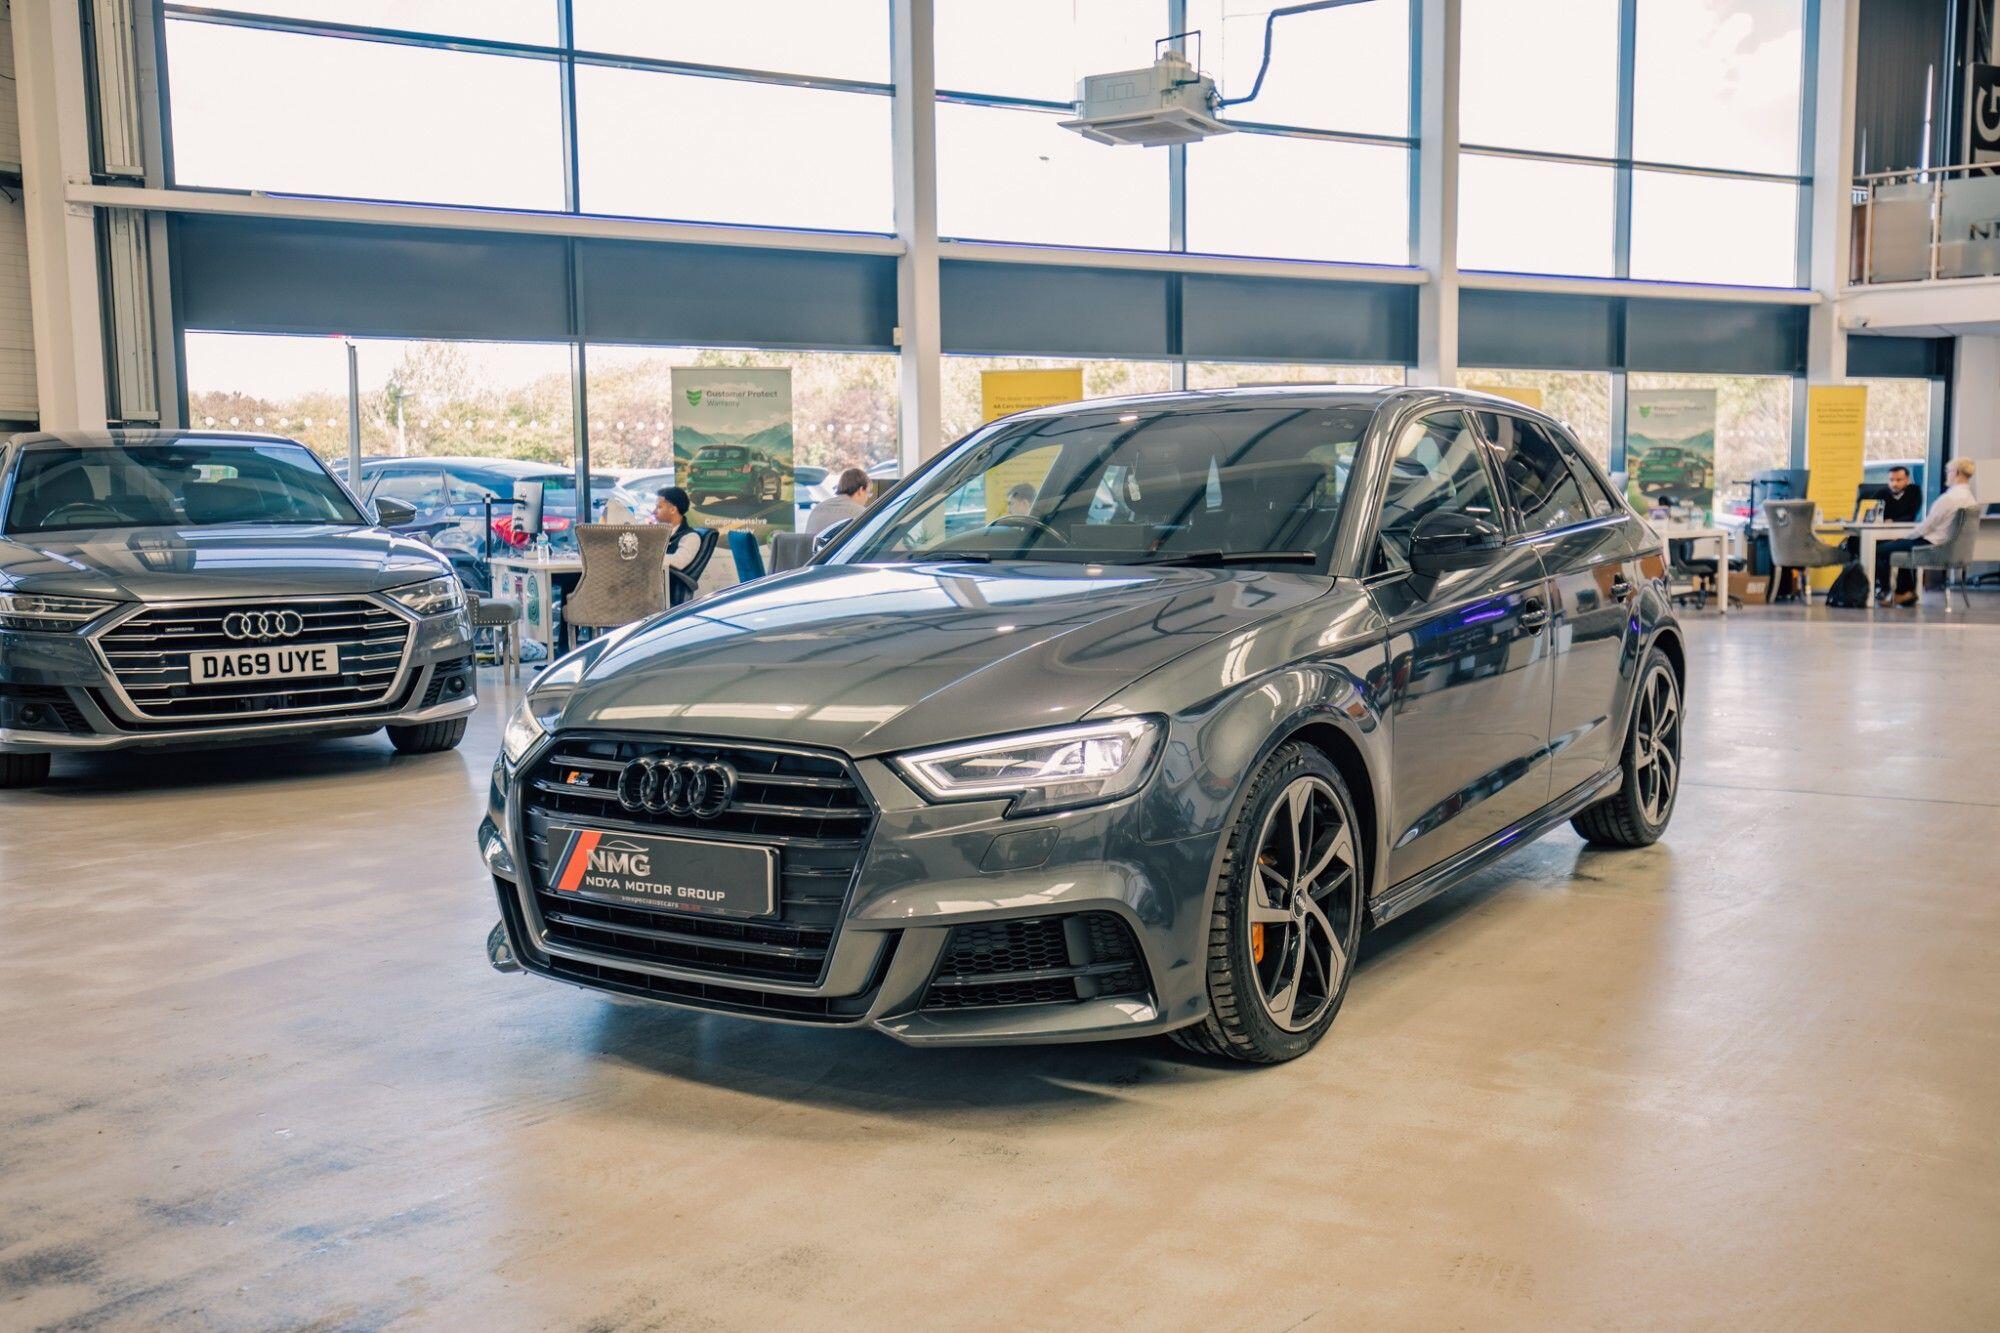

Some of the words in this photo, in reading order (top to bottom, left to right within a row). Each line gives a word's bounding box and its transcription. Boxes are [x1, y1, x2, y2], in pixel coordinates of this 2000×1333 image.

[202, 653, 270, 679] DA69
[278, 649, 327, 673] UYE
[586, 849, 651, 877] NMG
[625, 880, 672, 896] MOTOR
[677, 886, 725, 901] GROUP
